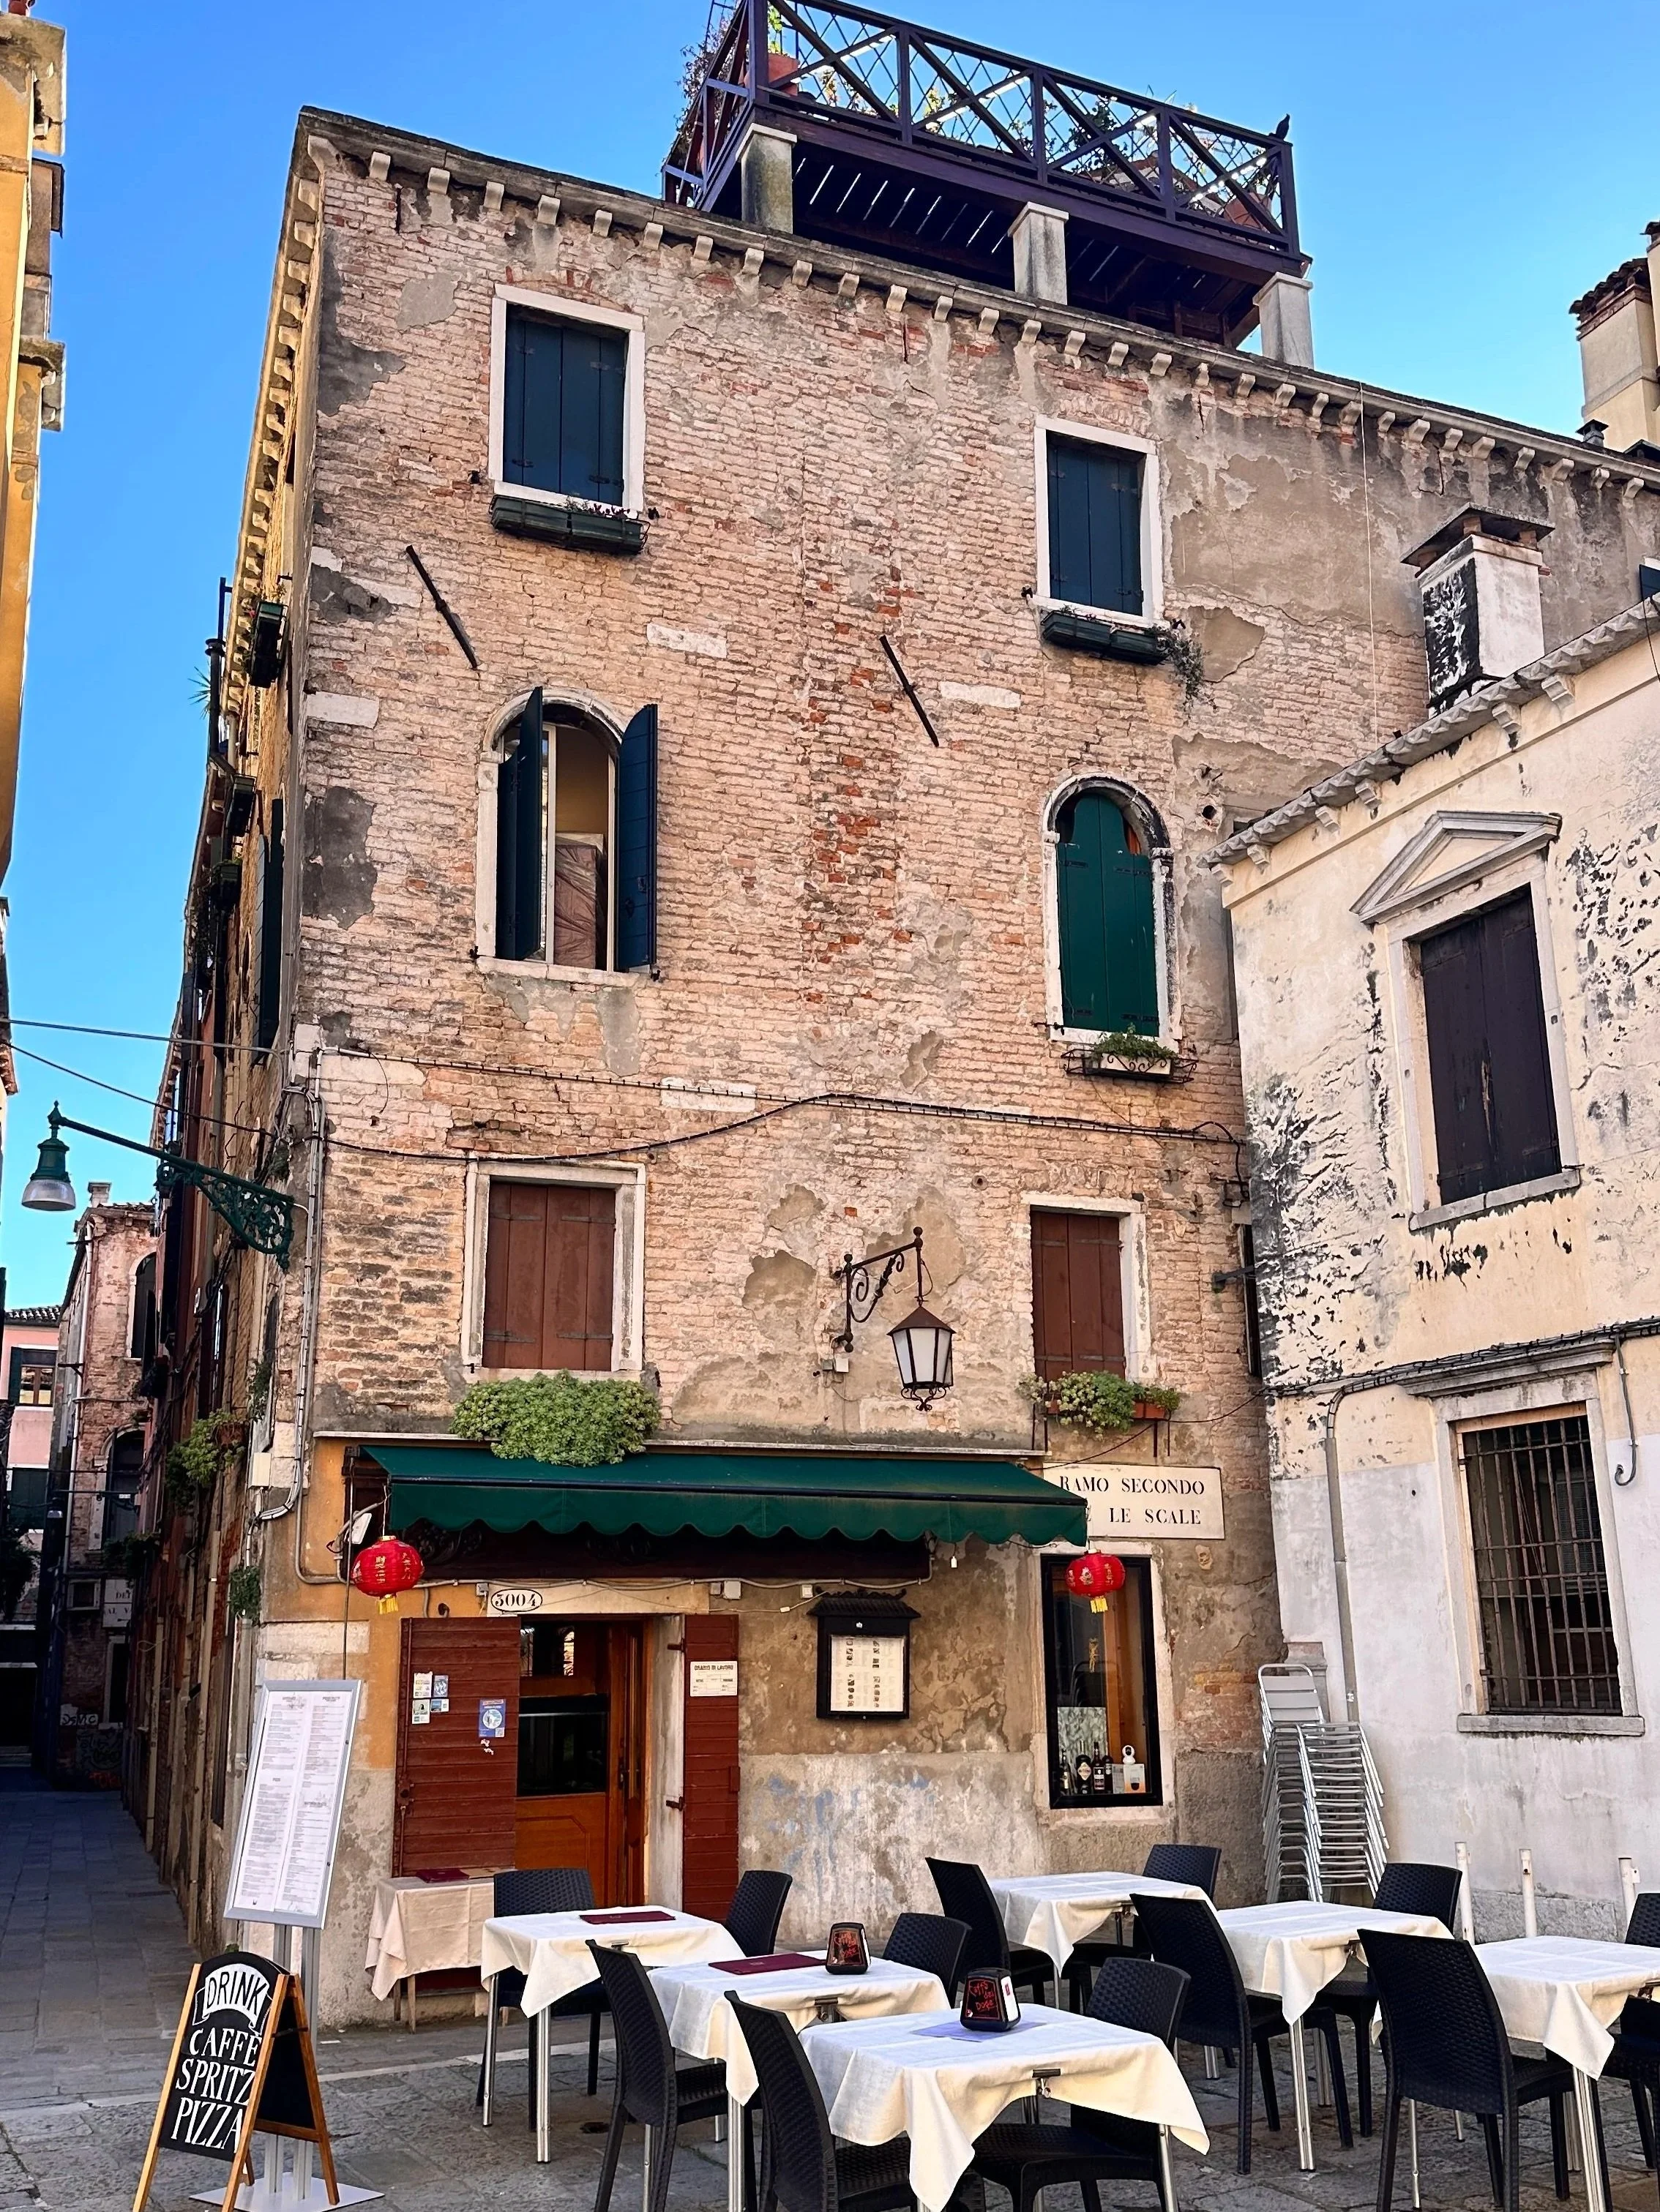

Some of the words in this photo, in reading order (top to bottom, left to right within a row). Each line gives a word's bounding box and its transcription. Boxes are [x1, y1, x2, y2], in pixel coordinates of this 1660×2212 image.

[1060, 1476, 1109, 1492] RAMO
[1121, 1477, 1205, 1495] SECONDO
[1110, 1507, 1131, 1523] LE
[1145, 1509, 1201, 1525] SCALE
[495, 1593, 536, 1607] 3004
[206, 1970, 268, 2017] DRINK
[175, 2058, 256, 2107] SPRITZ
[171, 2096, 244, 2153] PIZZA
